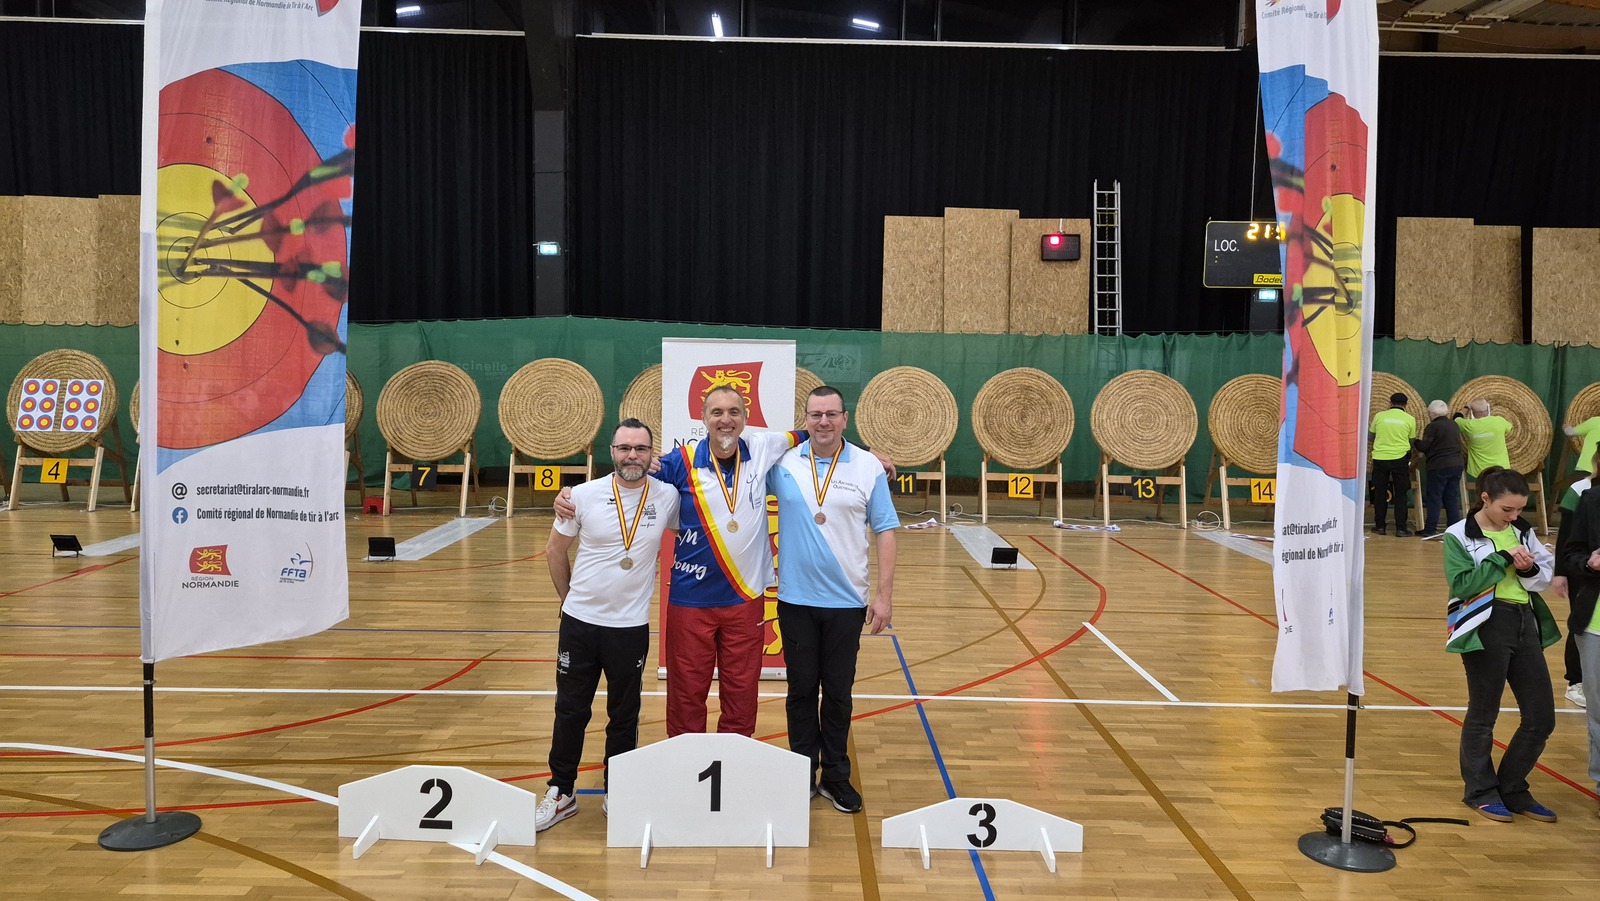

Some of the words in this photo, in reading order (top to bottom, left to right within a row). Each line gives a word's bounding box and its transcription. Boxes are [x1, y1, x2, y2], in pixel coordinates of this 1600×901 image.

[1214, 239, 1239, 252] LOC.
[47, 461, 60, 480] 4
[417, 467, 431, 486] 7
[541, 468, 553, 488] 8
[196, 483, 310, 498] secretariat@tiralarc-normandie.fr
[897, 474, 913, 493] 11
[1011, 476, 1031, 495] 12
[1133, 478, 1156, 499] 13
[1253, 481, 1274, 500] 14
[197, 508, 223, 520] Comité
[224, 508, 254, 522] régional
[255, 508, 265, 519] de
[266, 508, 298, 521] Normandie
[300, 510, 307, 522] de
[308, 511, 316, 522] tir
[318, 511, 323, 522] à
[324, 510, 339, 522] l'arc
[1307, 548, 1316, 560] de
[182, 580, 239, 589] NORMANDIE
[698, 760, 722, 812] 1
[418, 778, 453, 830] 2
[966, 803, 997, 848] 3
